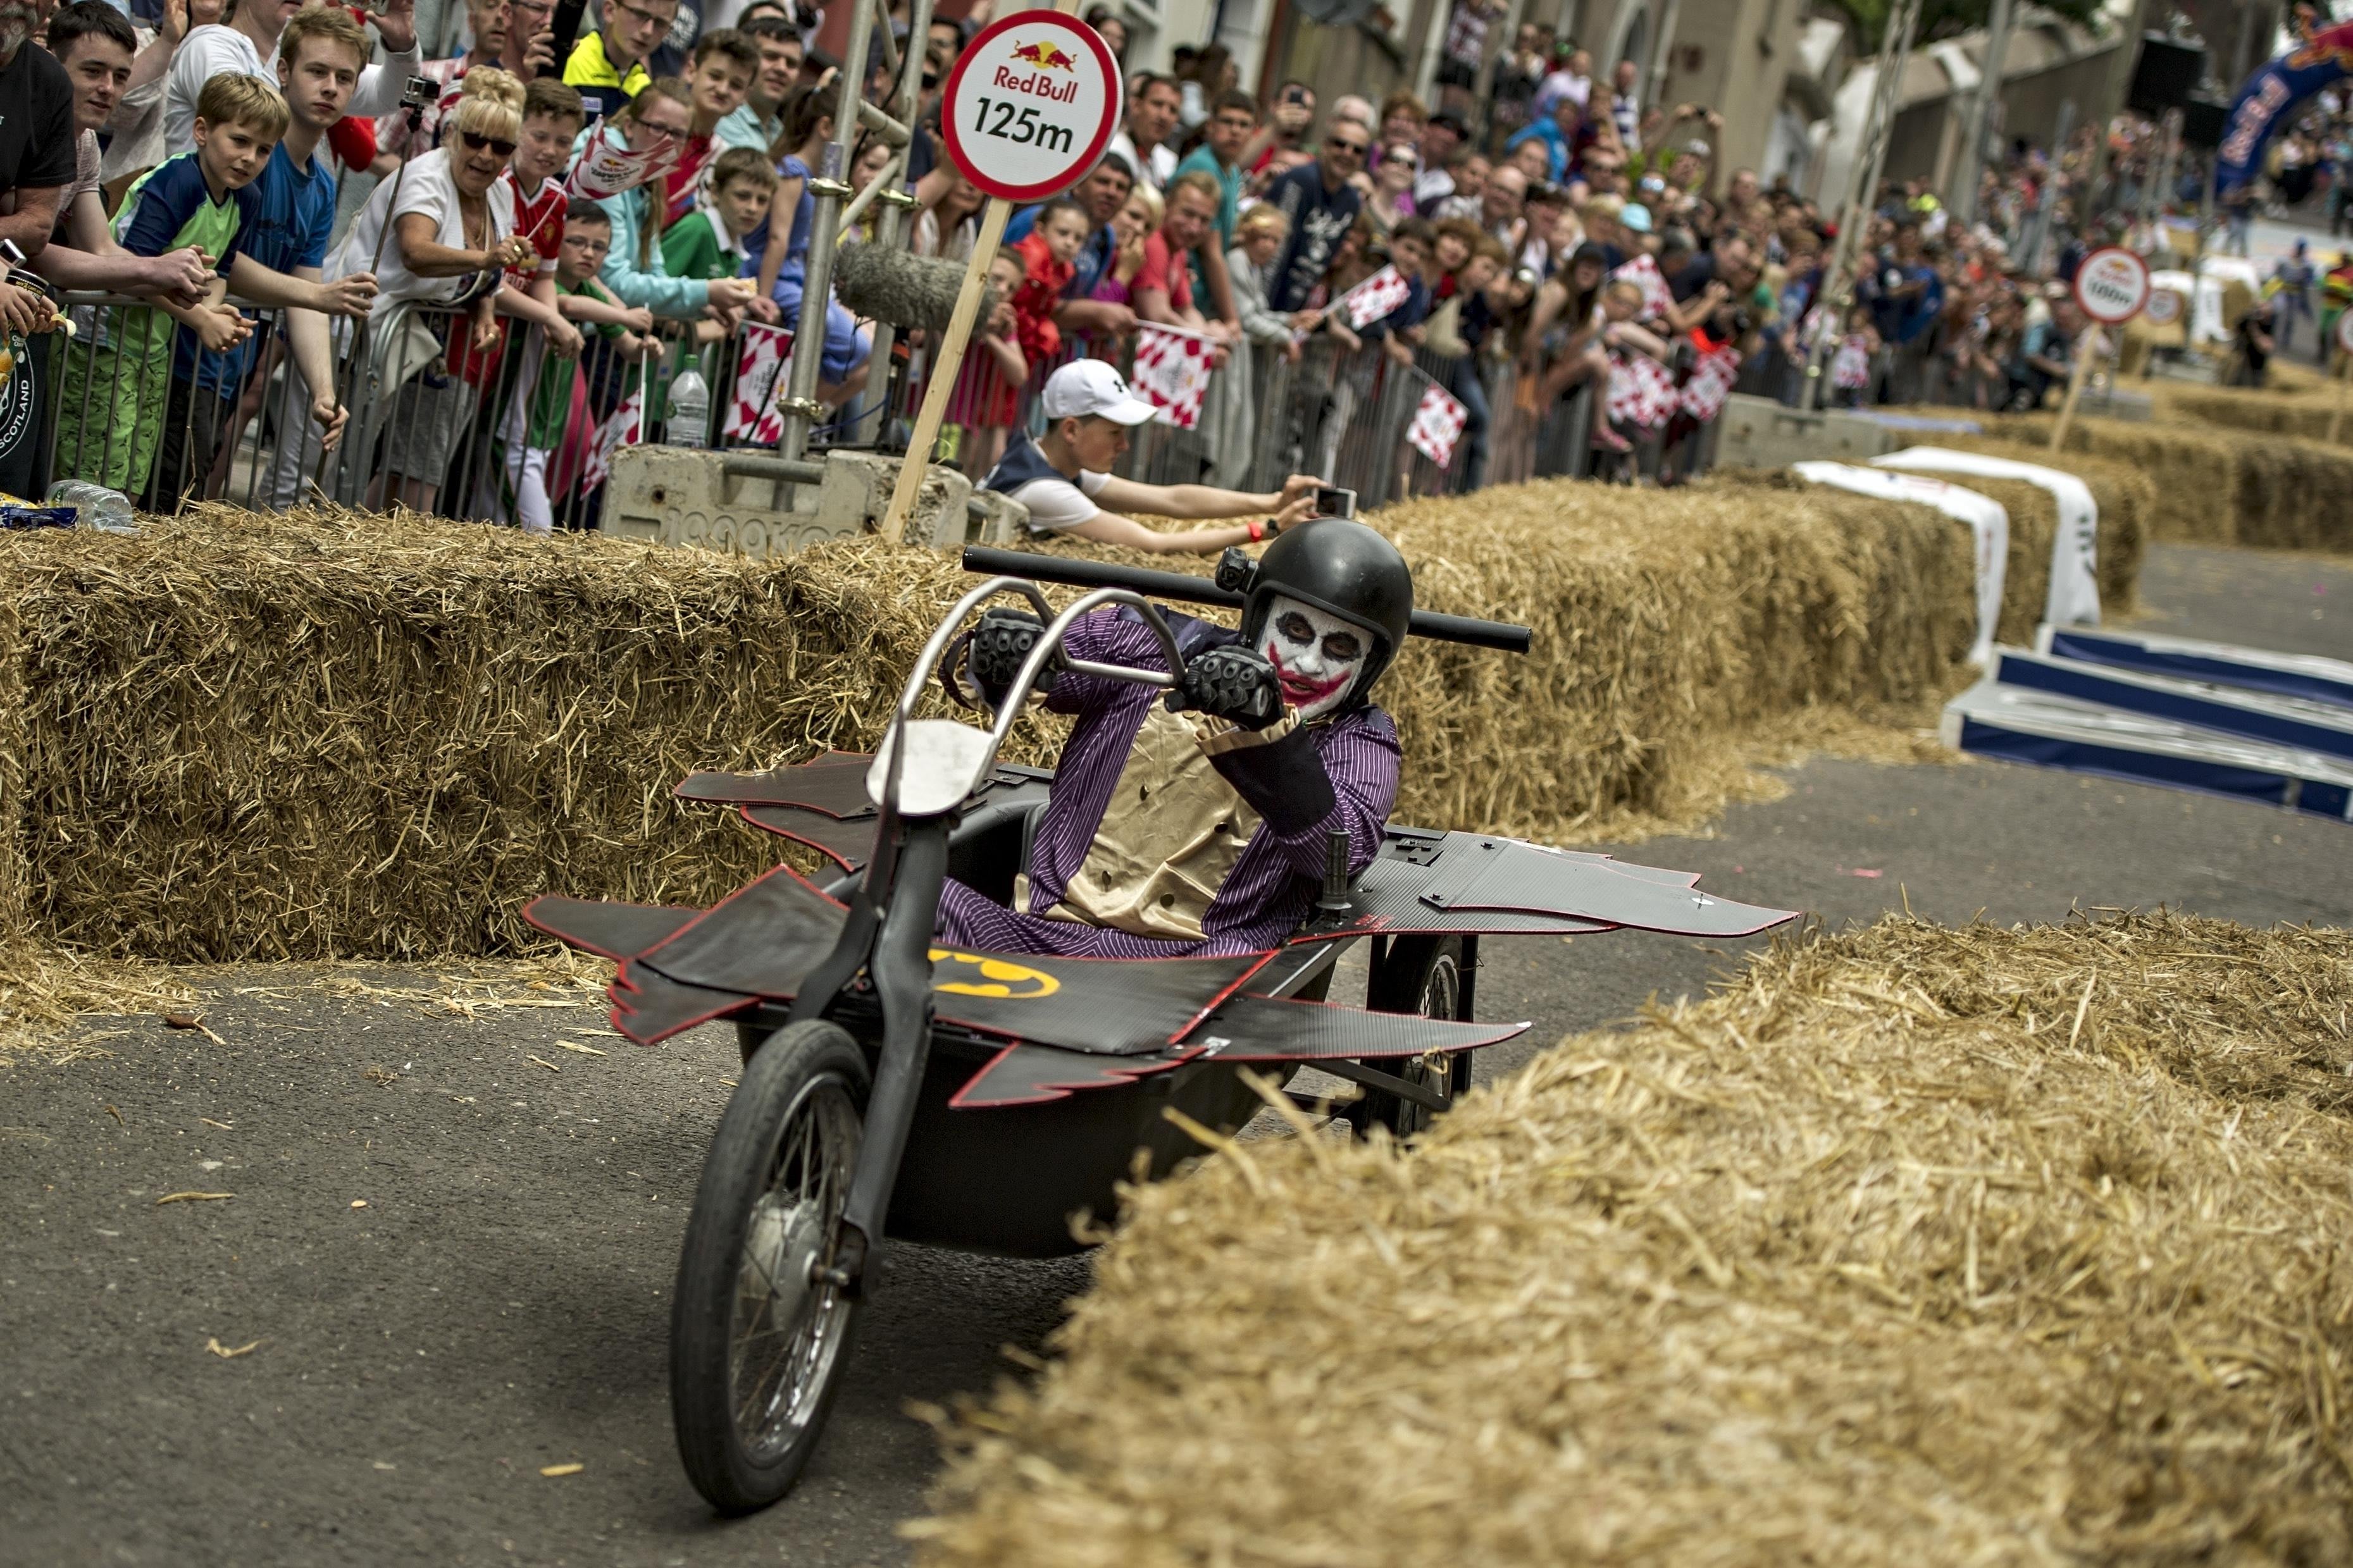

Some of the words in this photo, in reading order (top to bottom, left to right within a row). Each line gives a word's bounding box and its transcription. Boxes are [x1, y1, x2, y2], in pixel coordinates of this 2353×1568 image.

[993, 65, 1038, 94] Red
[1035, 75, 1079, 104] Bull
[974, 96, 1074, 154] 125m
